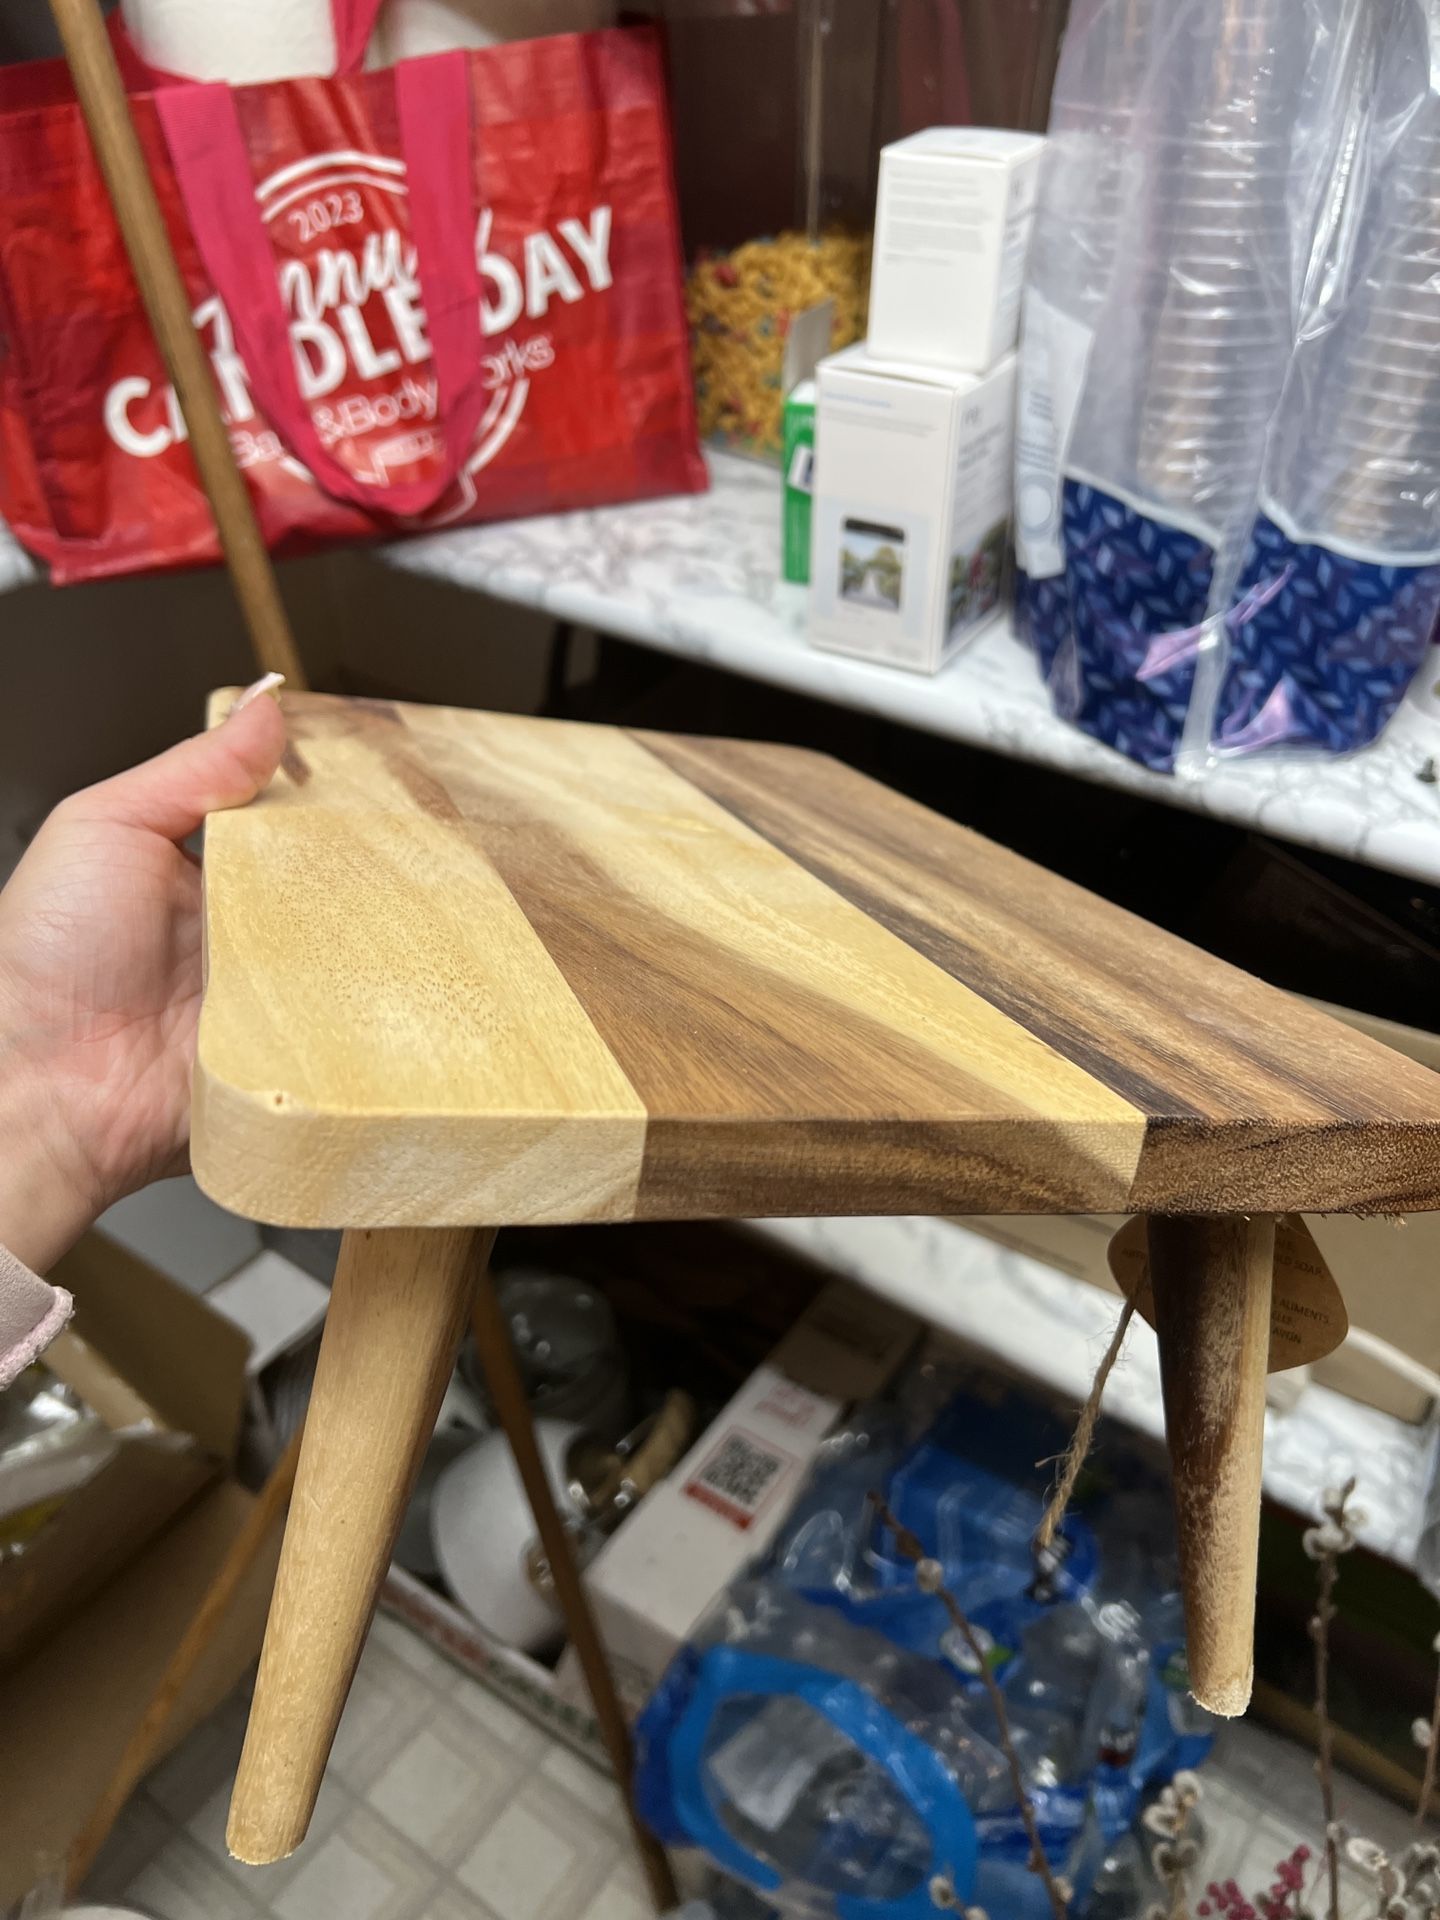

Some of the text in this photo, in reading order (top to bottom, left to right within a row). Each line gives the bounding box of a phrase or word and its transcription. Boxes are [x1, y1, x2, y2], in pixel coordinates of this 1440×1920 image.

[287, 189, 364, 242] 2023
[103, 204, 613, 458] CDLE DAY
